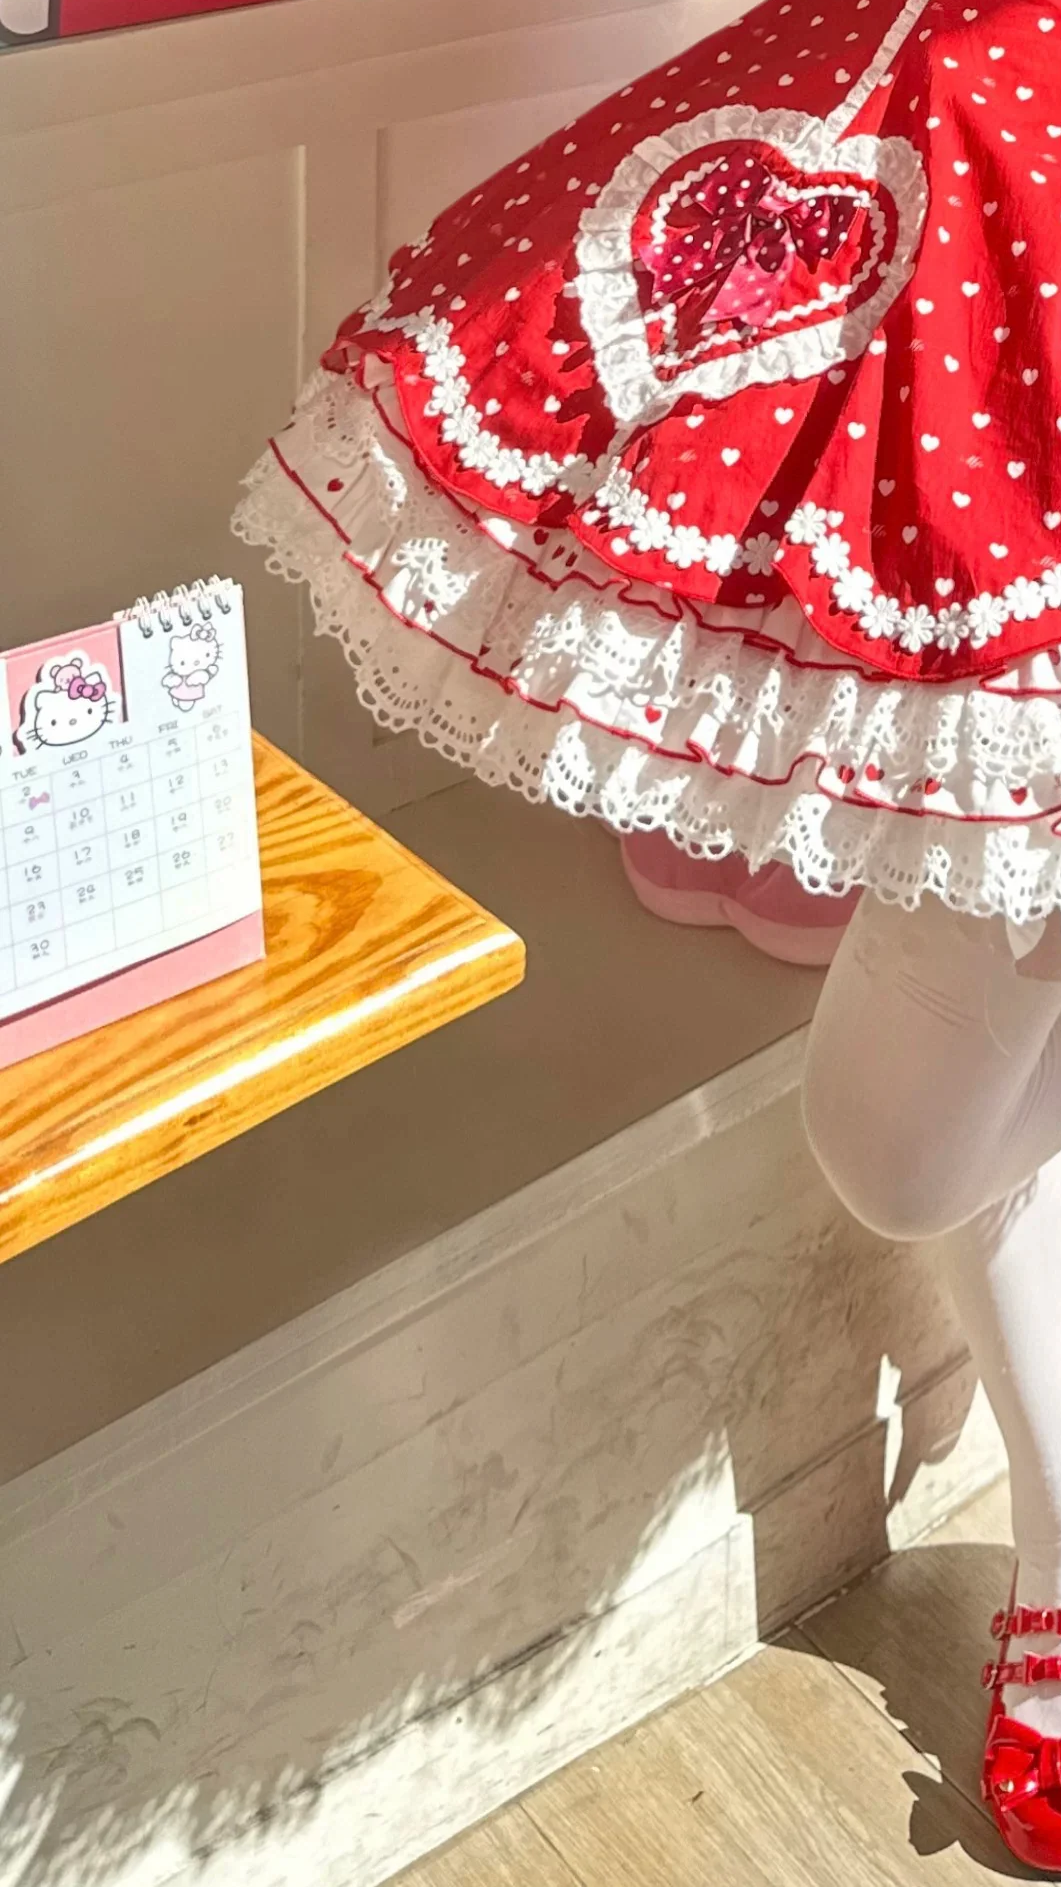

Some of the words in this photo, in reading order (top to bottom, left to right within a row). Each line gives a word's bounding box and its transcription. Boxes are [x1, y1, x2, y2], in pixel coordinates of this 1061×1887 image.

[13, 767, 37, 781] TUE
[63, 751, 87, 765] WED
[109, 737, 133, 749] THU
[158, 721, 178, 733] FRI
[22, 786, 31, 797] 2
[72, 807, 90, 820] 10
[120, 791, 136, 805] 11
[168, 774, 185, 788] 12
[24, 864, 42, 877] 16
[74, 846, 92, 861] 17
[124, 829, 141, 843] 18
[172, 850, 192, 864] 26
